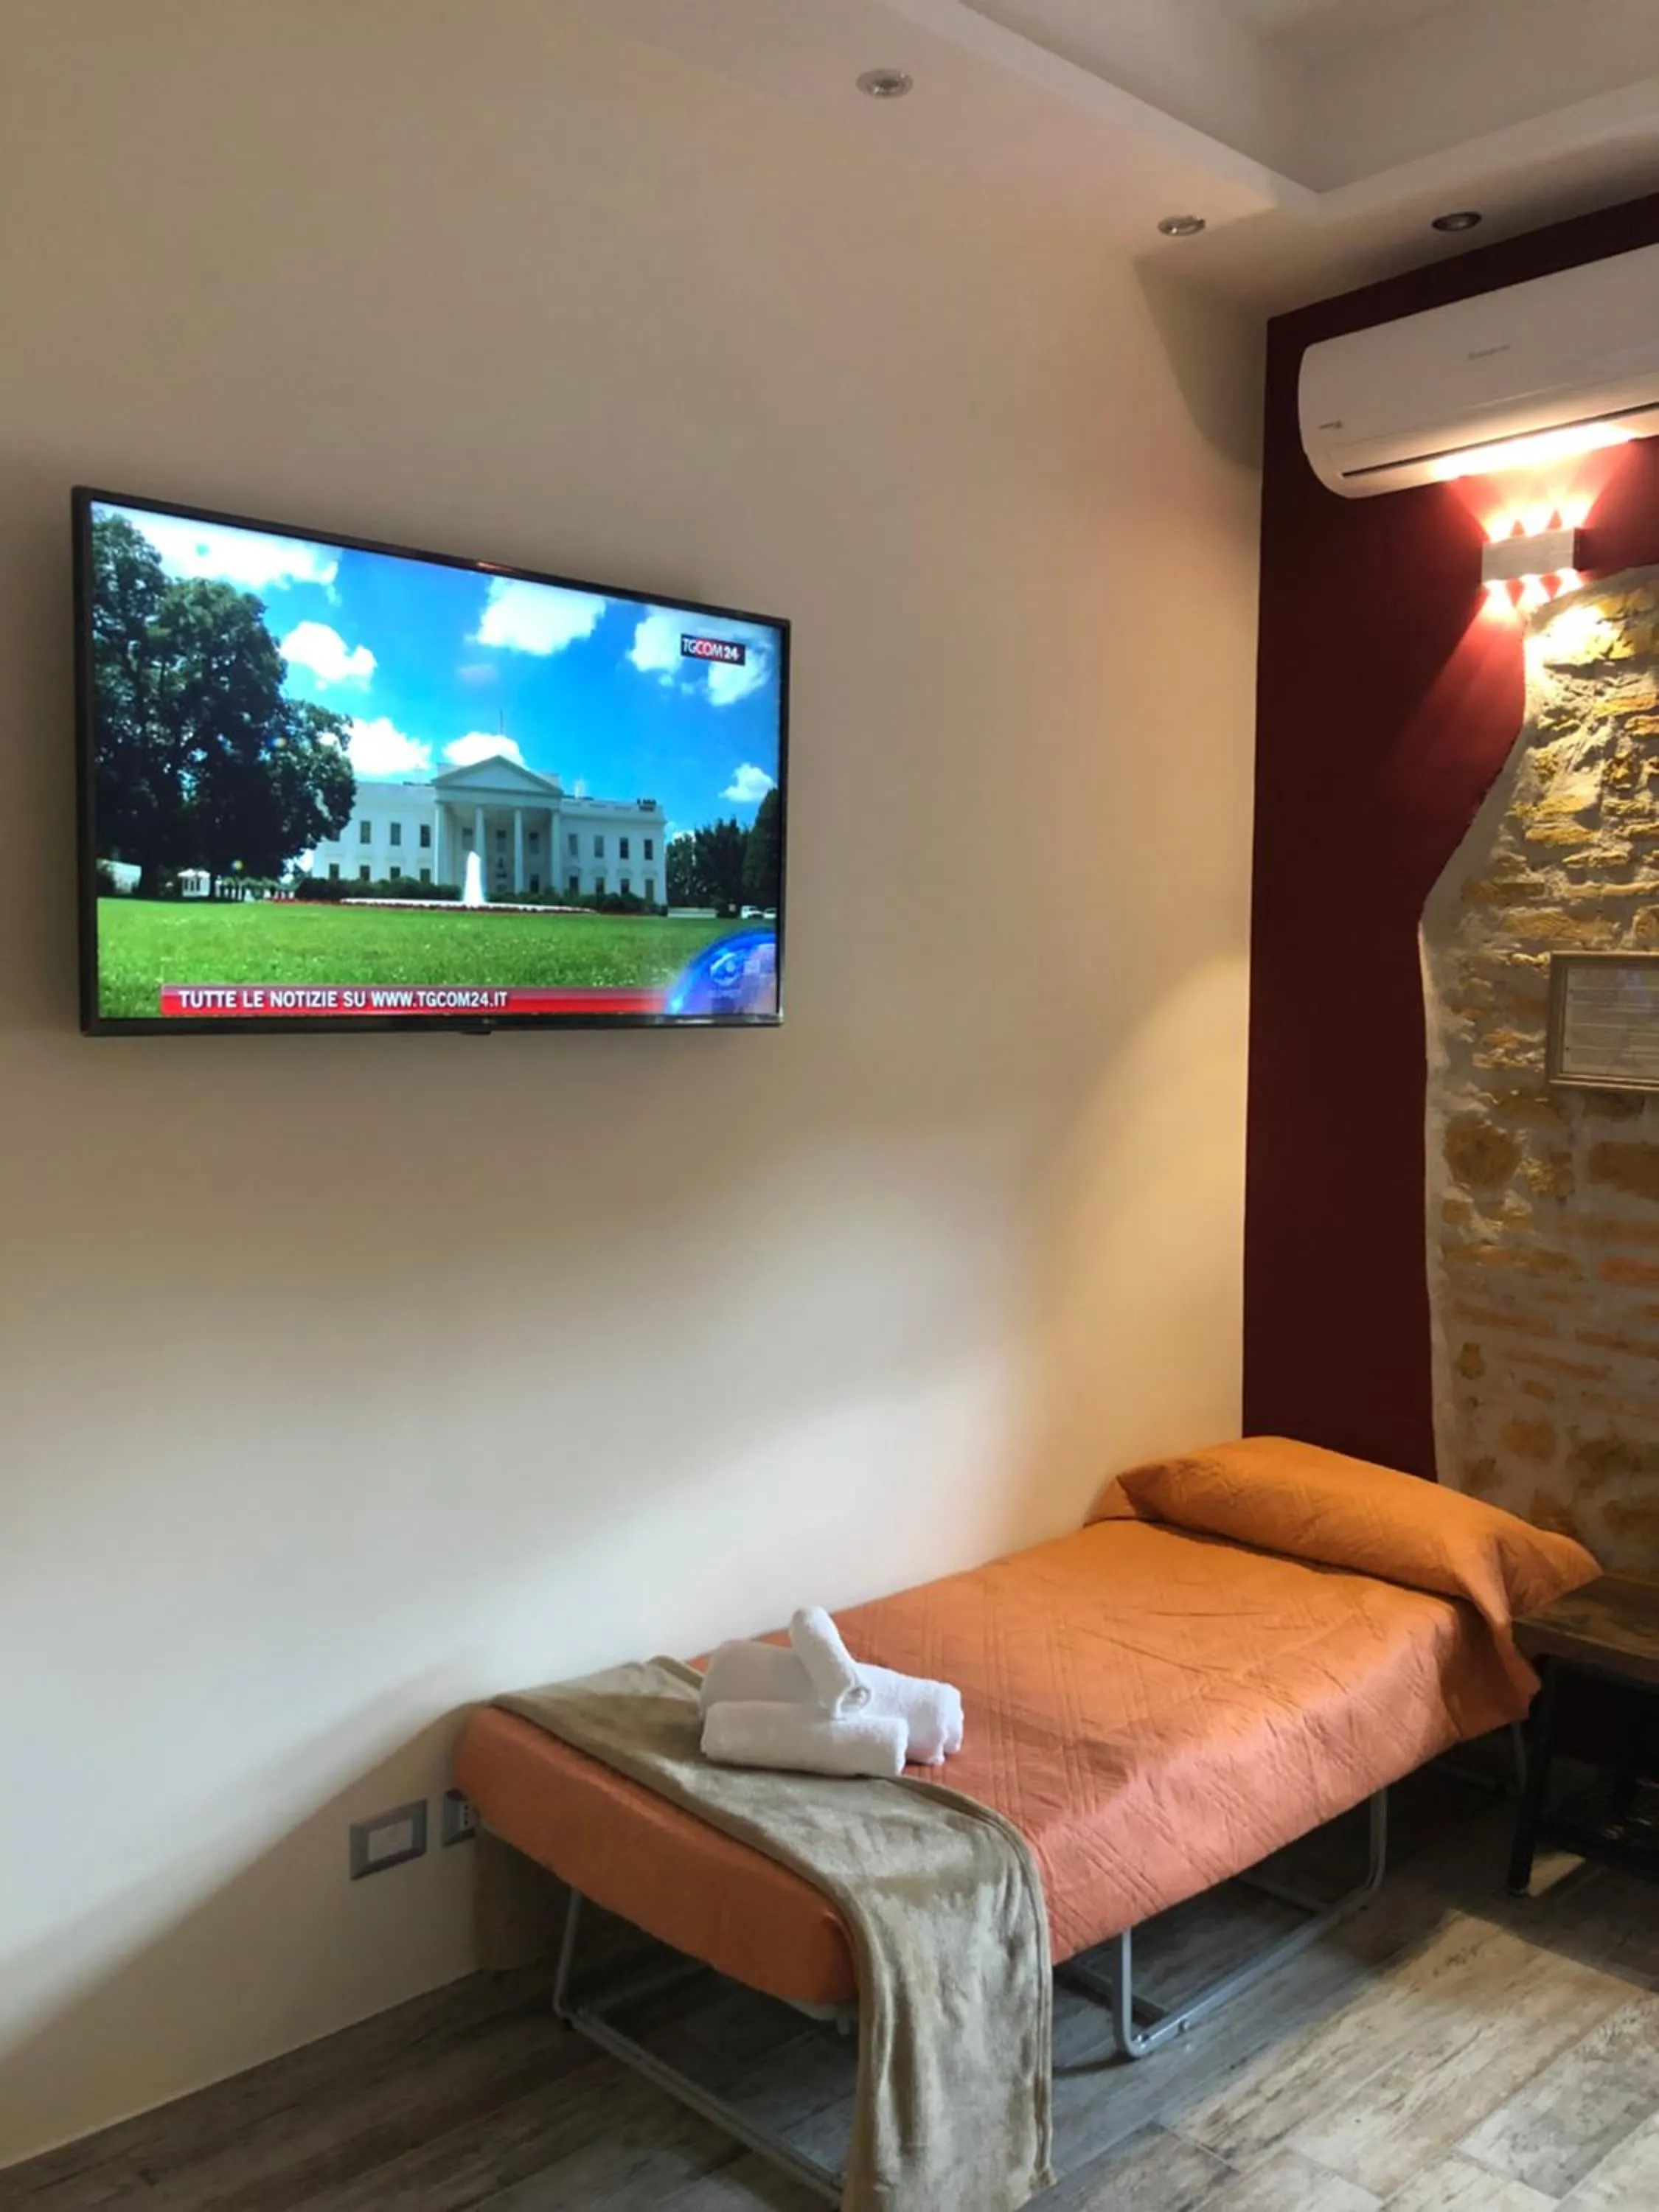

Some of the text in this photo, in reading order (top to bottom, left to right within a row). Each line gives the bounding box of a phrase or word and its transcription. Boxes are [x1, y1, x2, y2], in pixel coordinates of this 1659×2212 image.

[178, 990, 508, 1009] TUTTE LE NOTIZIE SU WWW.TGCOM24.IT
